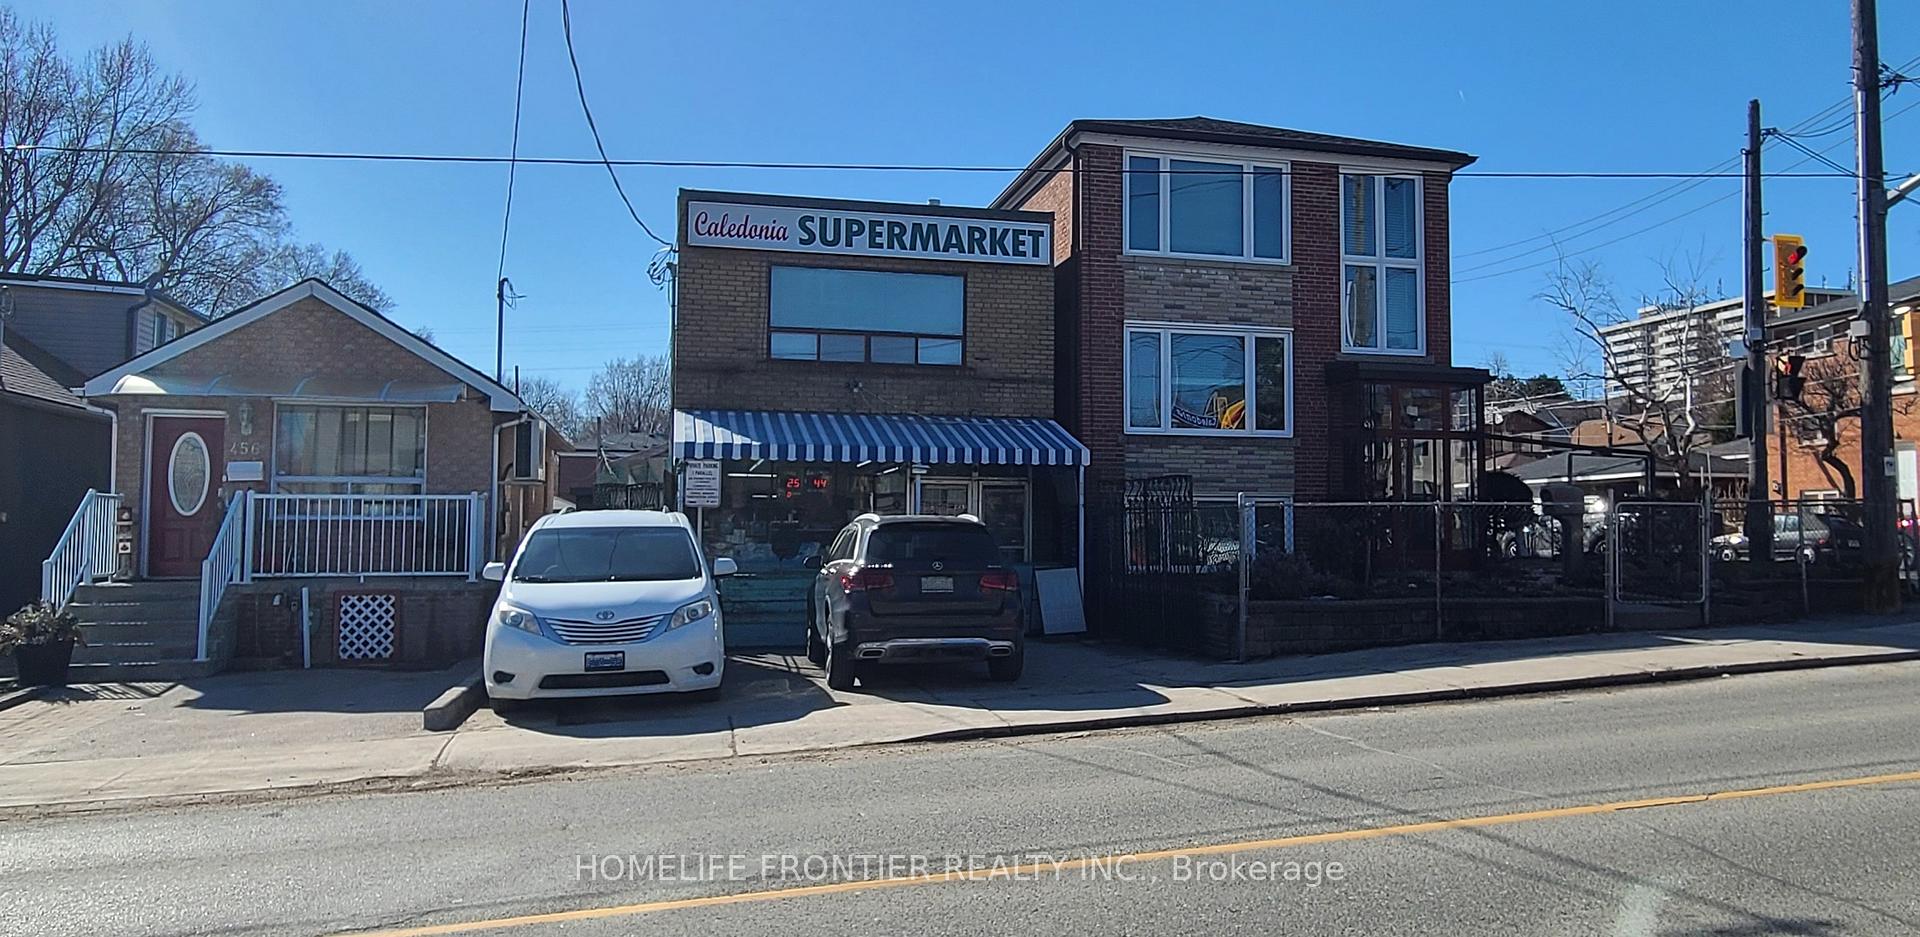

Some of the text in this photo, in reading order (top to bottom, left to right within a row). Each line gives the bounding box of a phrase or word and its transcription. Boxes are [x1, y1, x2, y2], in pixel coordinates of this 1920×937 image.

[694, 211, 1045, 258] Caledonia SUPERMARKET
[230, 442, 260, 455] 456
[786, 478, 800, 488] 25
[813, 479, 827, 488] 44
